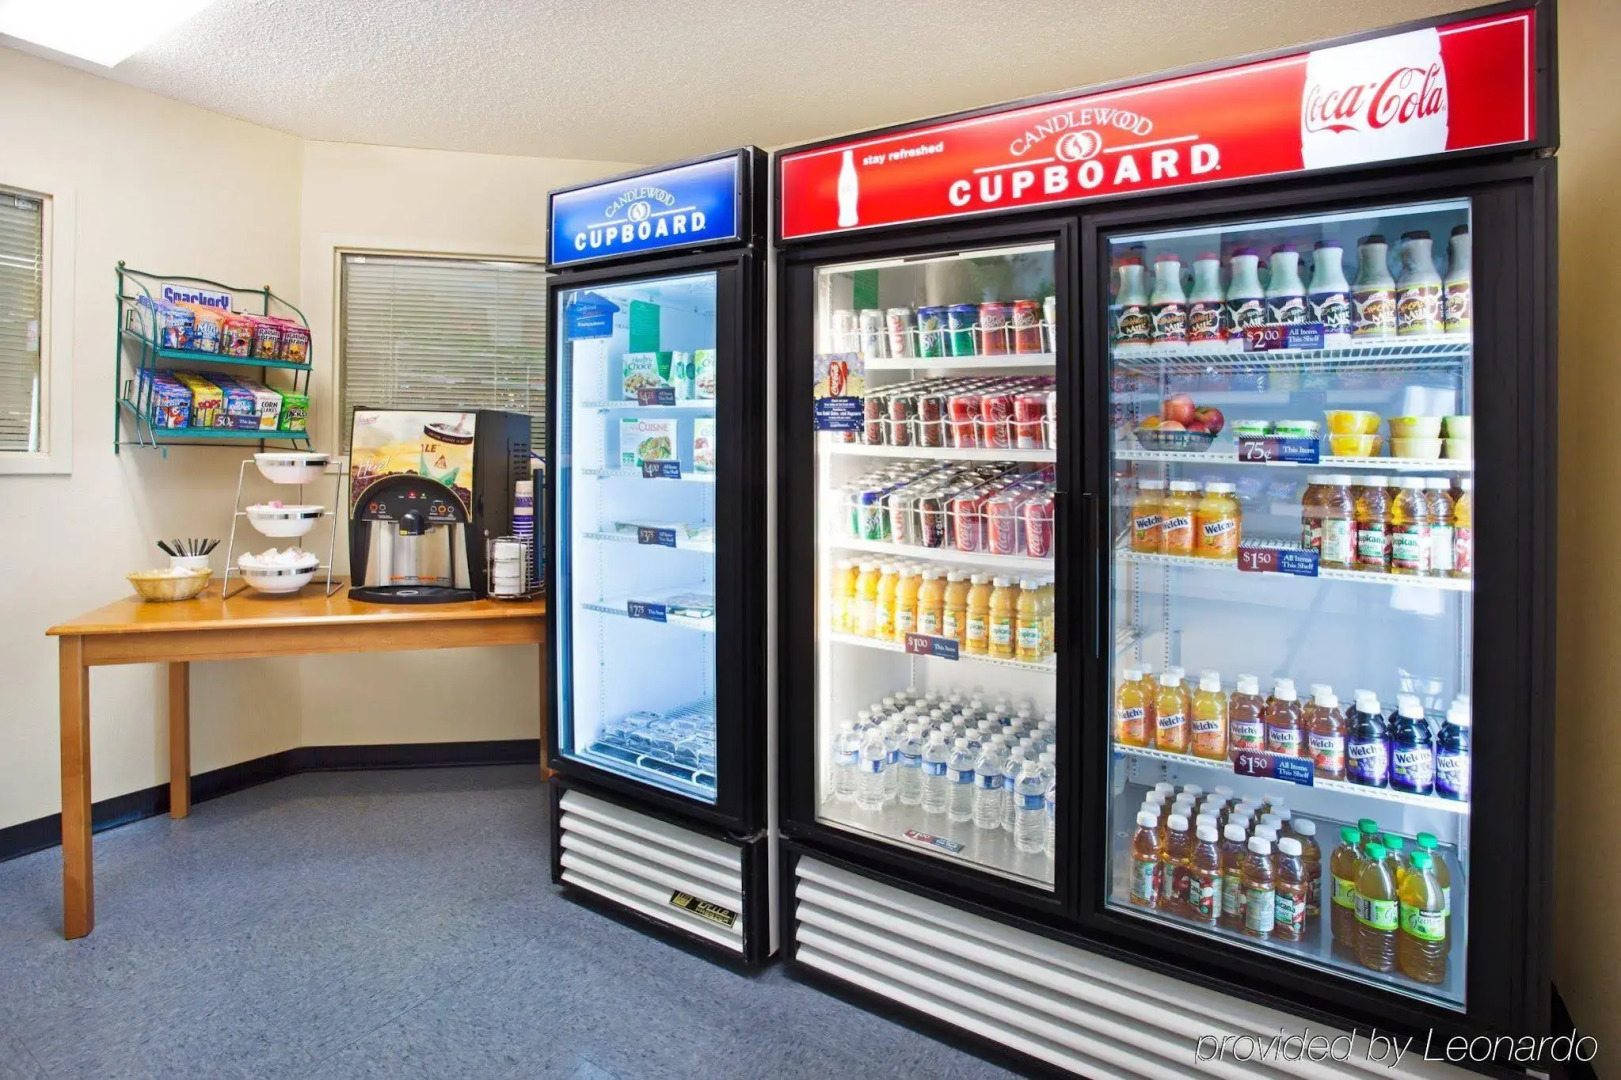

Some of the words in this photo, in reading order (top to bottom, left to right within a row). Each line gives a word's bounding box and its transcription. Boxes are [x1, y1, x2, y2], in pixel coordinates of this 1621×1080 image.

[1305, 63, 1443, 134] Coca-Cola
[1009, 107, 1153, 156] CANDLEWOOD
[863, 153, 886, 167] stay
[888, 141, 944, 162] refreshed
[948, 143, 1220, 207] CUPBOARD
[604, 187, 675, 218] CANDLEWOOD
[574, 211, 706, 251] CUPBOARD
[1164, 321, 1185, 333] MILK
[1302, 334, 1319, 342] Shelf
[638, 421, 669, 432] CUISINE
[1244, 441, 1272, 460] 75¢
[1283, 445, 1298, 454] This
[1299, 446, 1315, 454] Item
[1295, 554, 1312, 563] Items
[1282, 561, 1296, 569] This
[1297, 562, 1314, 570] Shelf
[1192, 721, 1219, 731] Welch's
[1278, 767, 1292, 776] This
[1293, 769, 1310, 778] Shelf
[1290, 763, 1308, 771] Items
